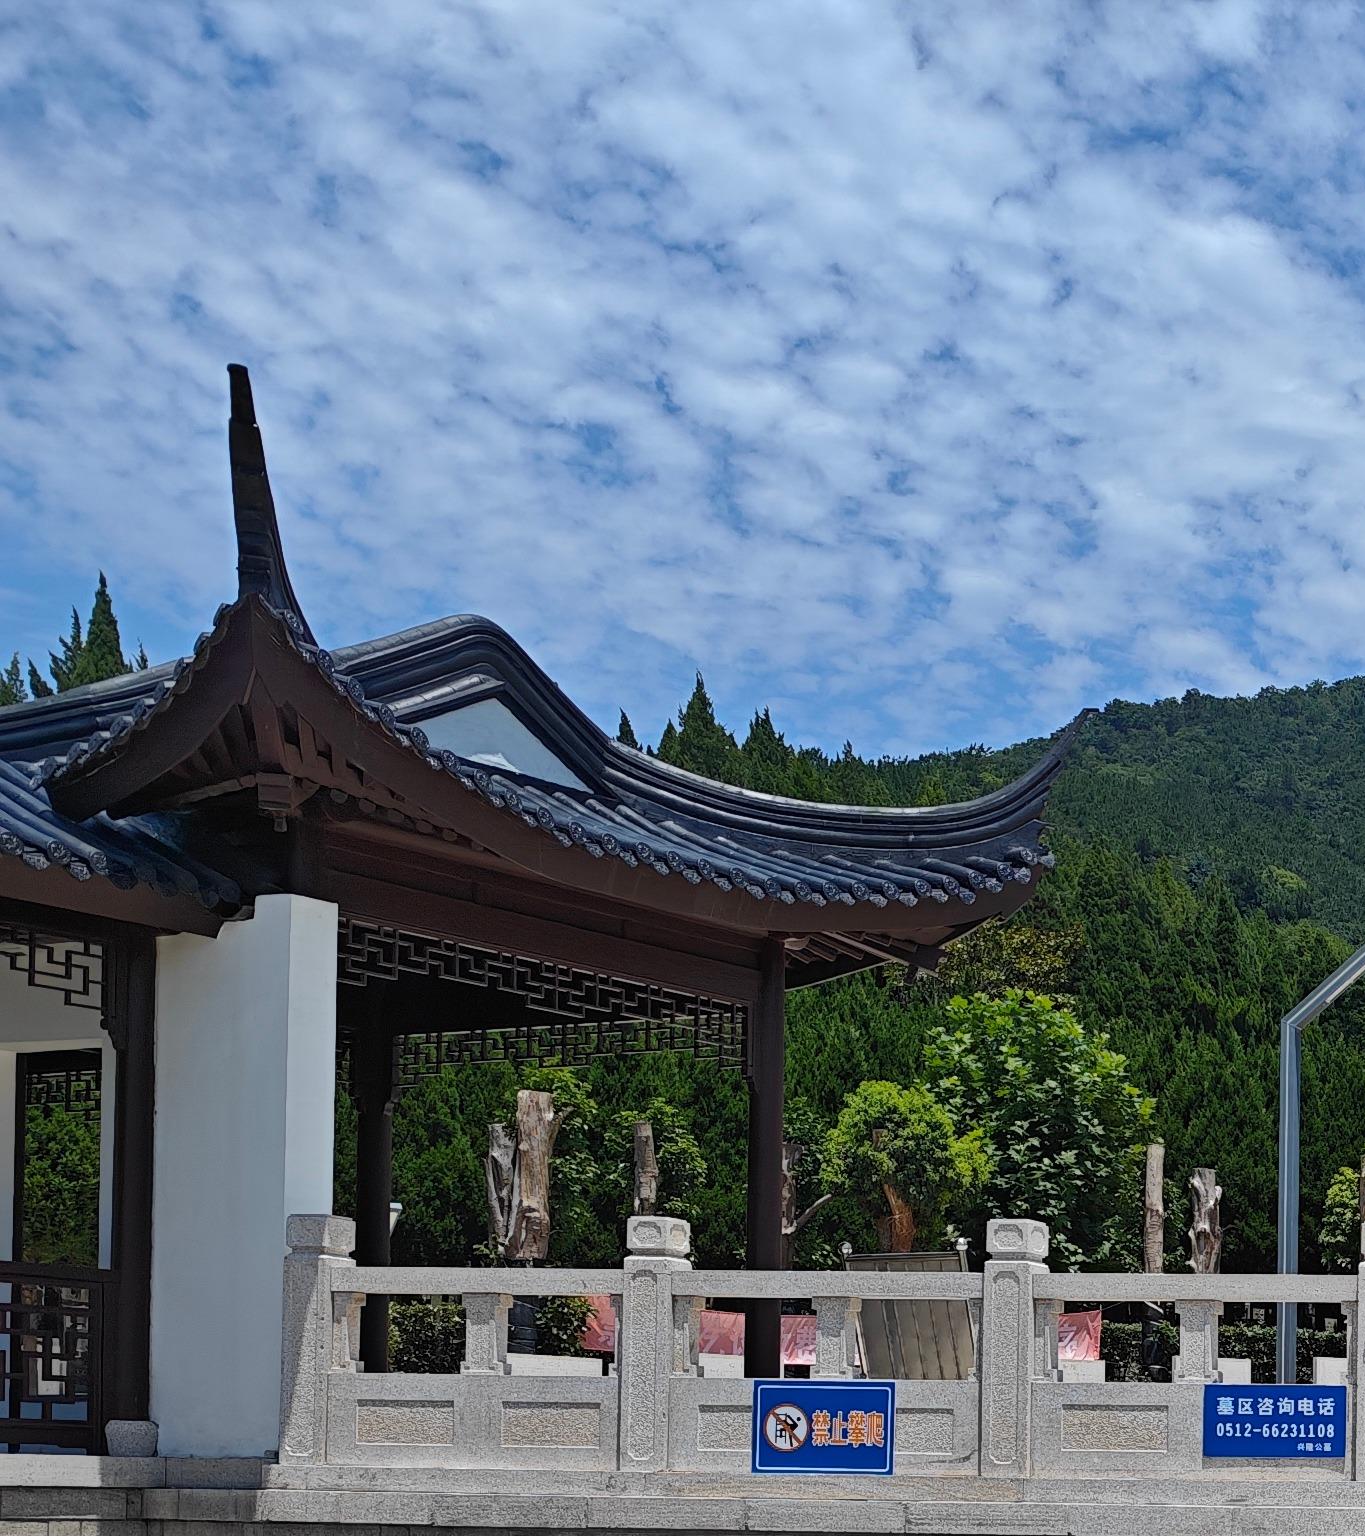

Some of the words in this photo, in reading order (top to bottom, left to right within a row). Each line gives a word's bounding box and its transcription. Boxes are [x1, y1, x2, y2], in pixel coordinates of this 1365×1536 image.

[1217, 1397, 1335, 1416] 墓区咨询电话
[811, 1409, 885, 1448] 禁止攀爬
[1216, 1422, 1335, 1438] 0512-66231108
